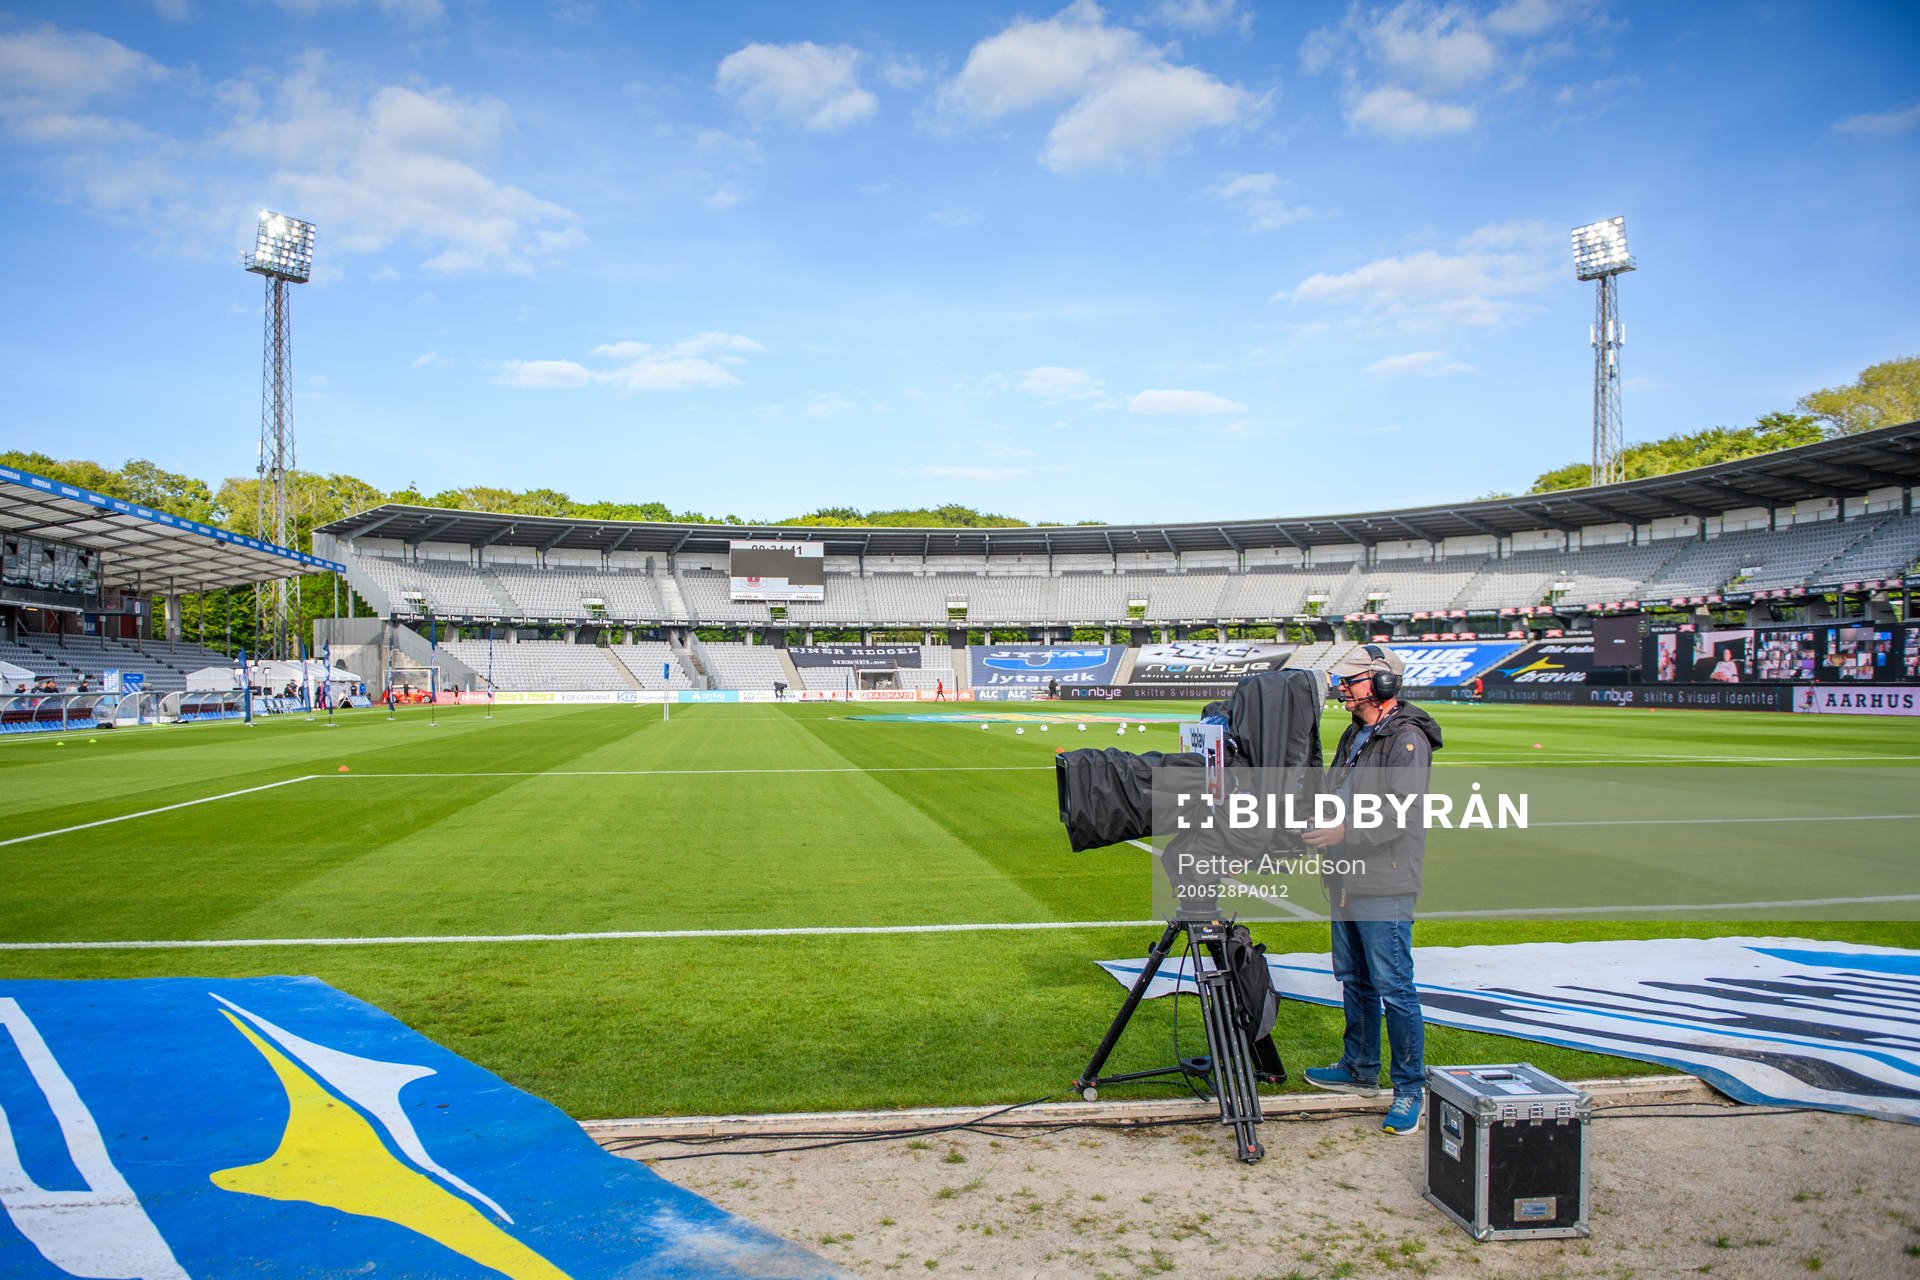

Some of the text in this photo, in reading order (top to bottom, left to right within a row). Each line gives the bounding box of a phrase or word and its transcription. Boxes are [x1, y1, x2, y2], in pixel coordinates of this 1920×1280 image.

[1145, 661, 1271, 674] nonbye
[987, 673, 1096, 684] jytas.dk
[866, 691, 914, 700] BAUHAUS
[979, 690, 999, 698] ALC
[1007, 690, 1027, 698] ALC
[1071, 687, 1122, 700] nonbye
[1134, 688, 1165, 697] skilte
[1180, 688, 1212, 697] visuel
[1591, 688, 1633, 706] nonbye
[1643, 691, 1673, 703] skilte
[1687, 692, 1721, 704] visuel
[1825, 693, 1914, 708] AARHUS
